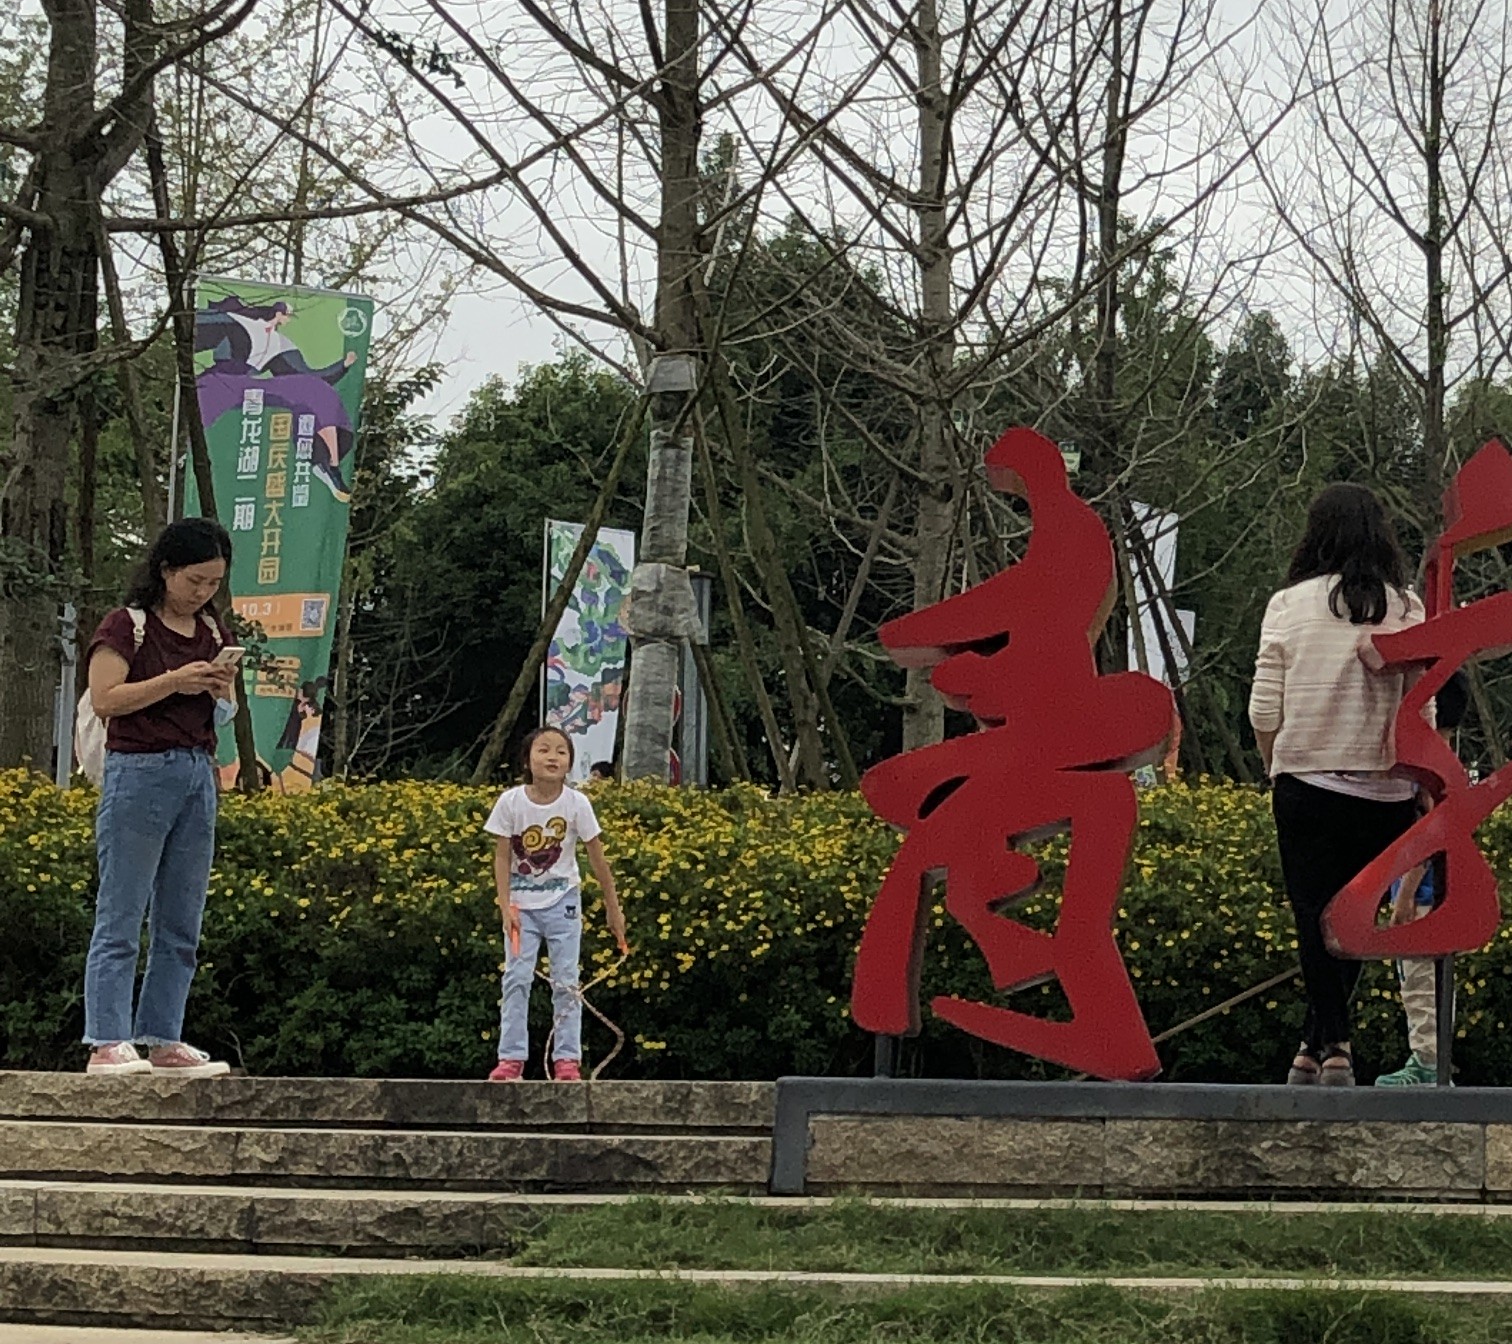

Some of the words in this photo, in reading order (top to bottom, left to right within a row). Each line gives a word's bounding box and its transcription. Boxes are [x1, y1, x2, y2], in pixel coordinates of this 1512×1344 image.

[257, 411, 292, 585] 国庆盛大开园
